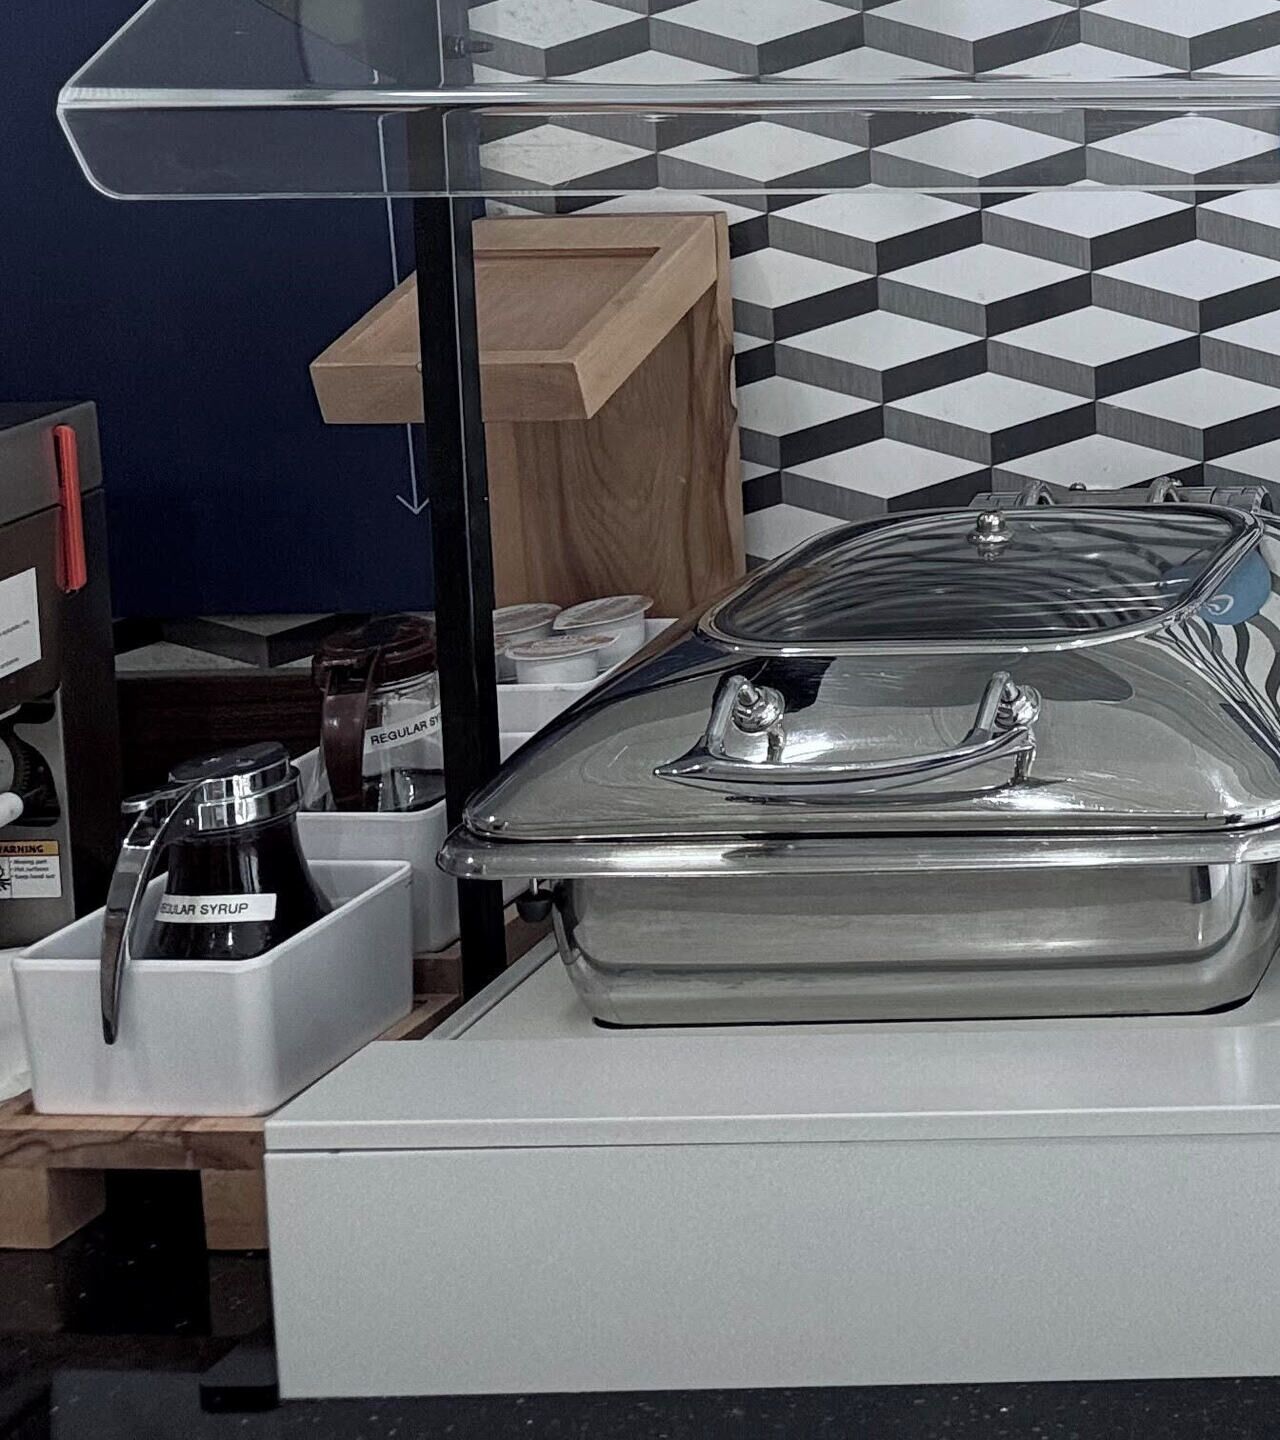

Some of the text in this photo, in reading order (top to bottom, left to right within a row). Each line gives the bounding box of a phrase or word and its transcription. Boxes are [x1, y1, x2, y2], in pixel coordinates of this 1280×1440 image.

[370, 720, 428, 745] REGULAR
[0, 844, 44, 854] ARNING
[200, 902, 249, 915] SYRUP
